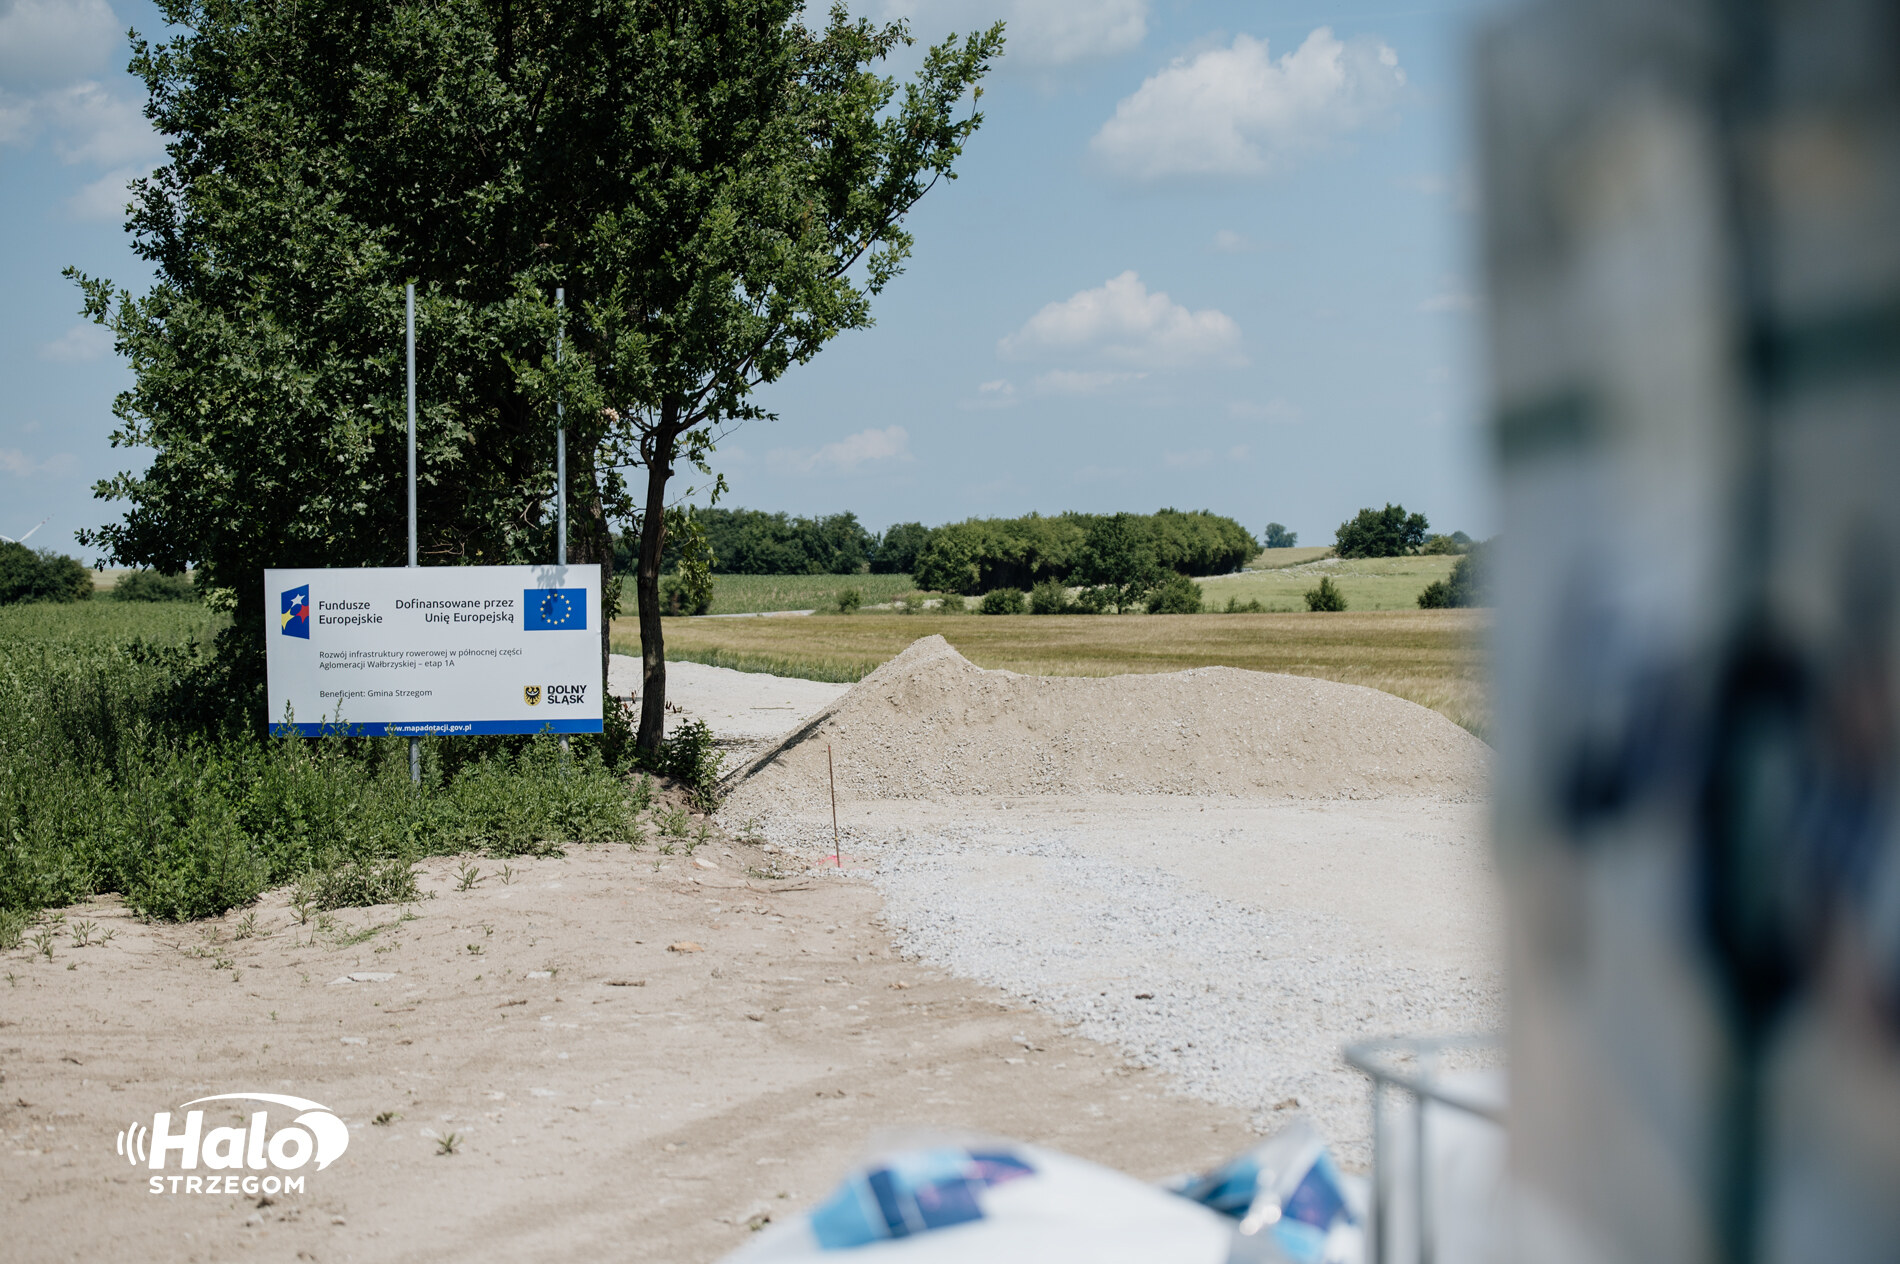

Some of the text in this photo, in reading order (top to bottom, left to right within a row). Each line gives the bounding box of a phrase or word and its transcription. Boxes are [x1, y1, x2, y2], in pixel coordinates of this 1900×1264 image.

[319, 600, 370, 610] Fundusze
[396, 599, 514, 609] Dofinansowane przez
[319, 614, 383, 626] Europejskie
[425, 612, 514, 625] Unię Europejską
[319, 651, 347, 660] Rozwój
[349, 649, 404, 658] infrastruktury
[405, 649, 448, 658] rowerowej
[458, 648, 497, 657] północnej
[499, 648, 522, 657] części
[319, 660, 365, 670] Aglomeracji
[367, 659, 416, 669] Wałbrzyskiej
[424, 660, 442, 668] etap
[320, 688, 433, 699] Beneficjent: Gmina Strzegom
[547, 685, 587, 694] DOLNY
[547, 693, 584, 705] ŚLĄSK
